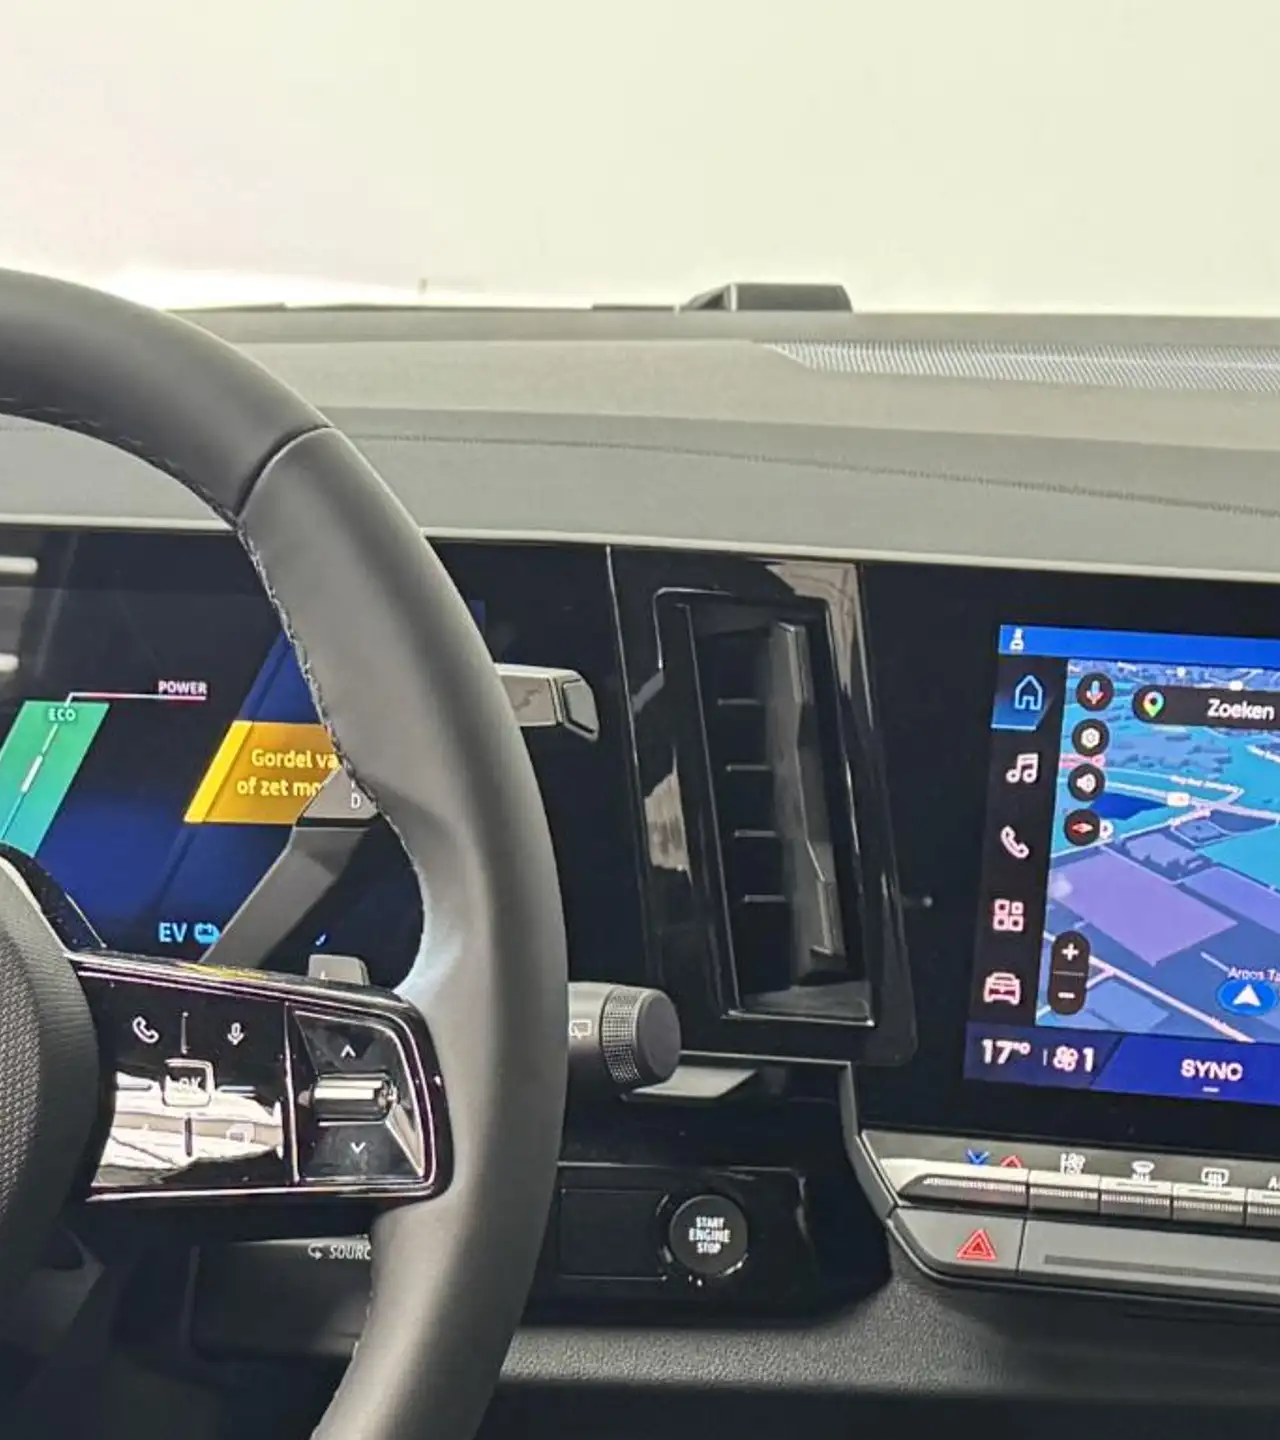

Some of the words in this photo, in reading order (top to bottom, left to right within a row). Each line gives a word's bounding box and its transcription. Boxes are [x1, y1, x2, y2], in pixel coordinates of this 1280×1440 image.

[157, 680, 208, 694] POWER
[47, 707, 77, 722] ECO
[1206, 697, 1275, 721] Zoeken
[251, 748, 314, 769] Gordel
[236, 776, 258, 795] of
[259, 779, 290, 797] zet
[350, 792, 362, 809] D
[157, 922, 188, 943] EV
[1180, 1058, 1244, 1082] SYNC
[695, 1216, 725, 1229] START
[688, 1228, 732, 1242] ENGINE
[696, 1241, 722, 1254] STOP
